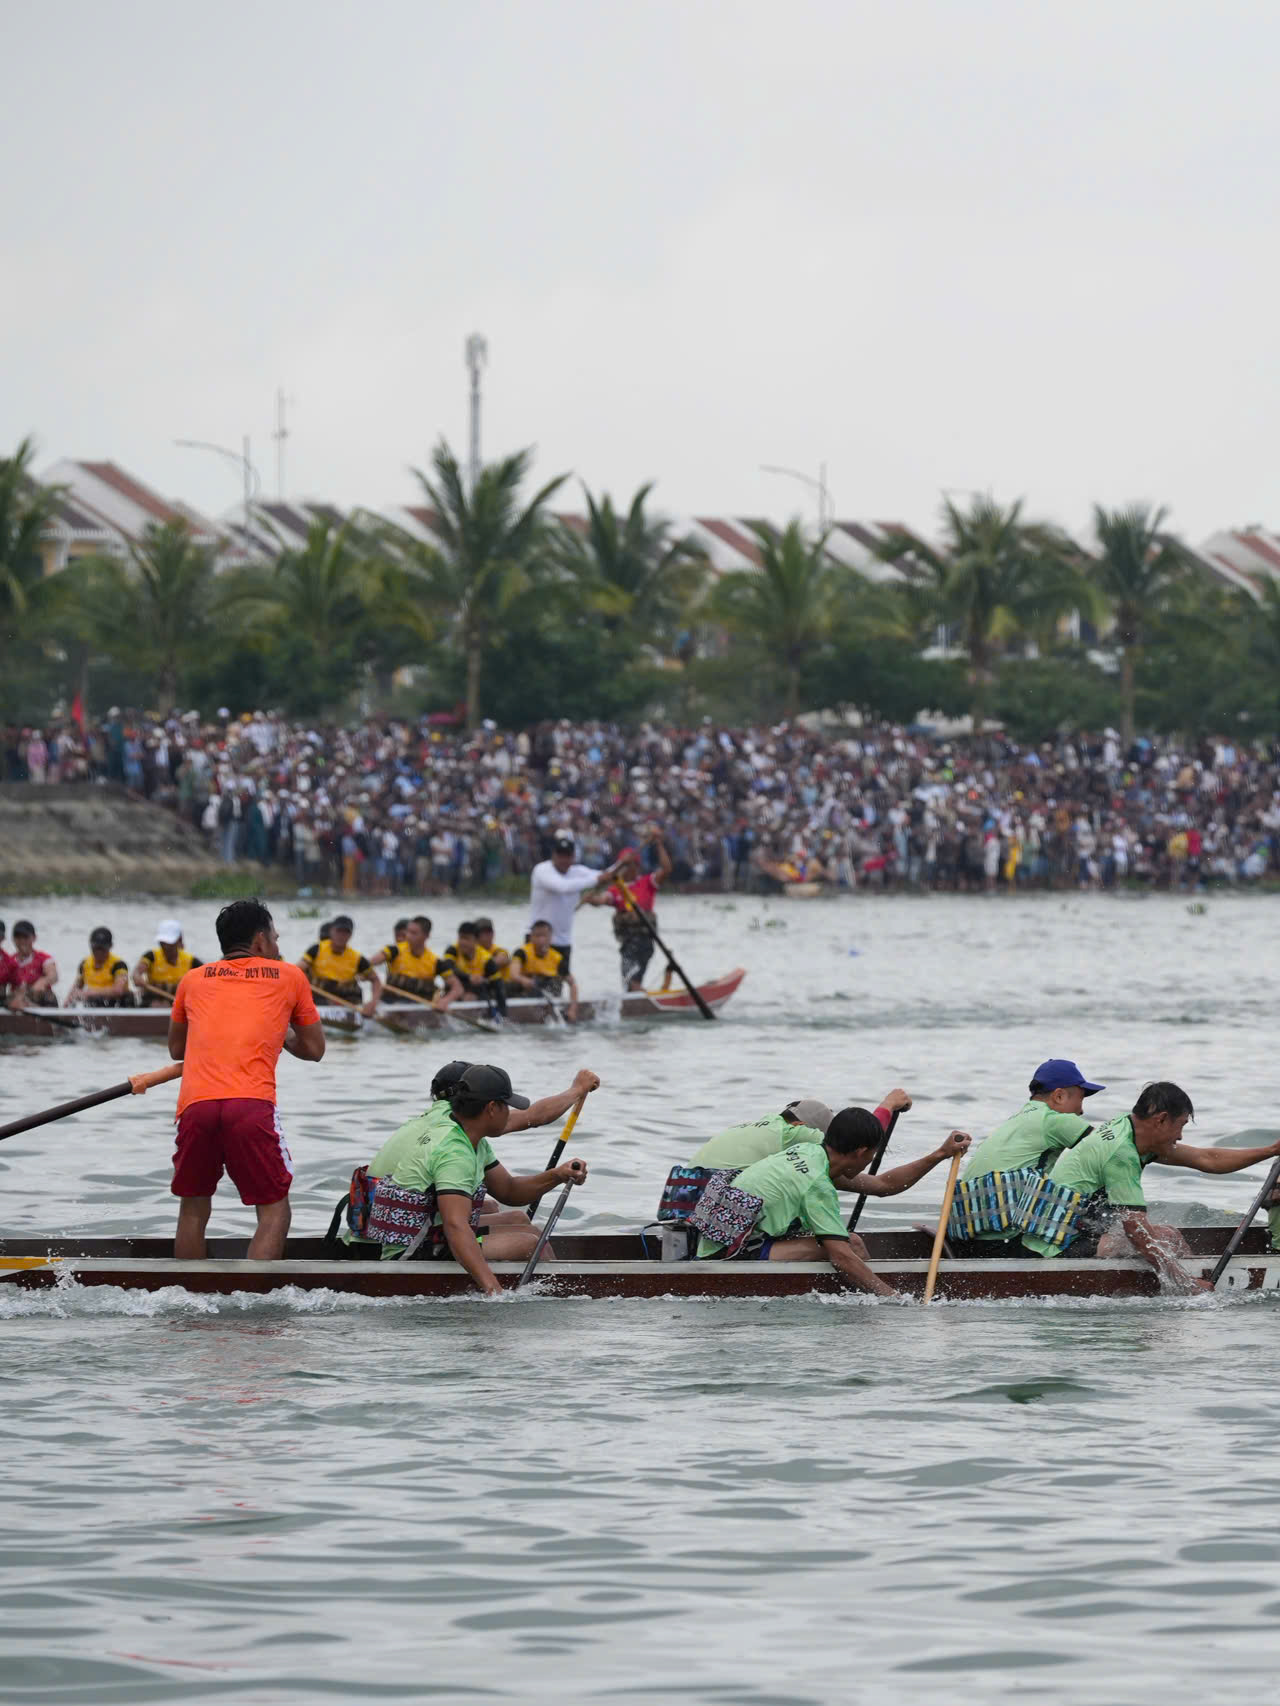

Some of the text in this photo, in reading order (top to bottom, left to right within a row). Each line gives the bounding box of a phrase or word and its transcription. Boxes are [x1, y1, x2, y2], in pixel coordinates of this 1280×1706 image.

[244, 967, 260, 979] DUY
[260, 967, 280, 980] VINH
[1100, 1129, 1115, 1141] NP
[792, 1160, 810, 1175] NP
